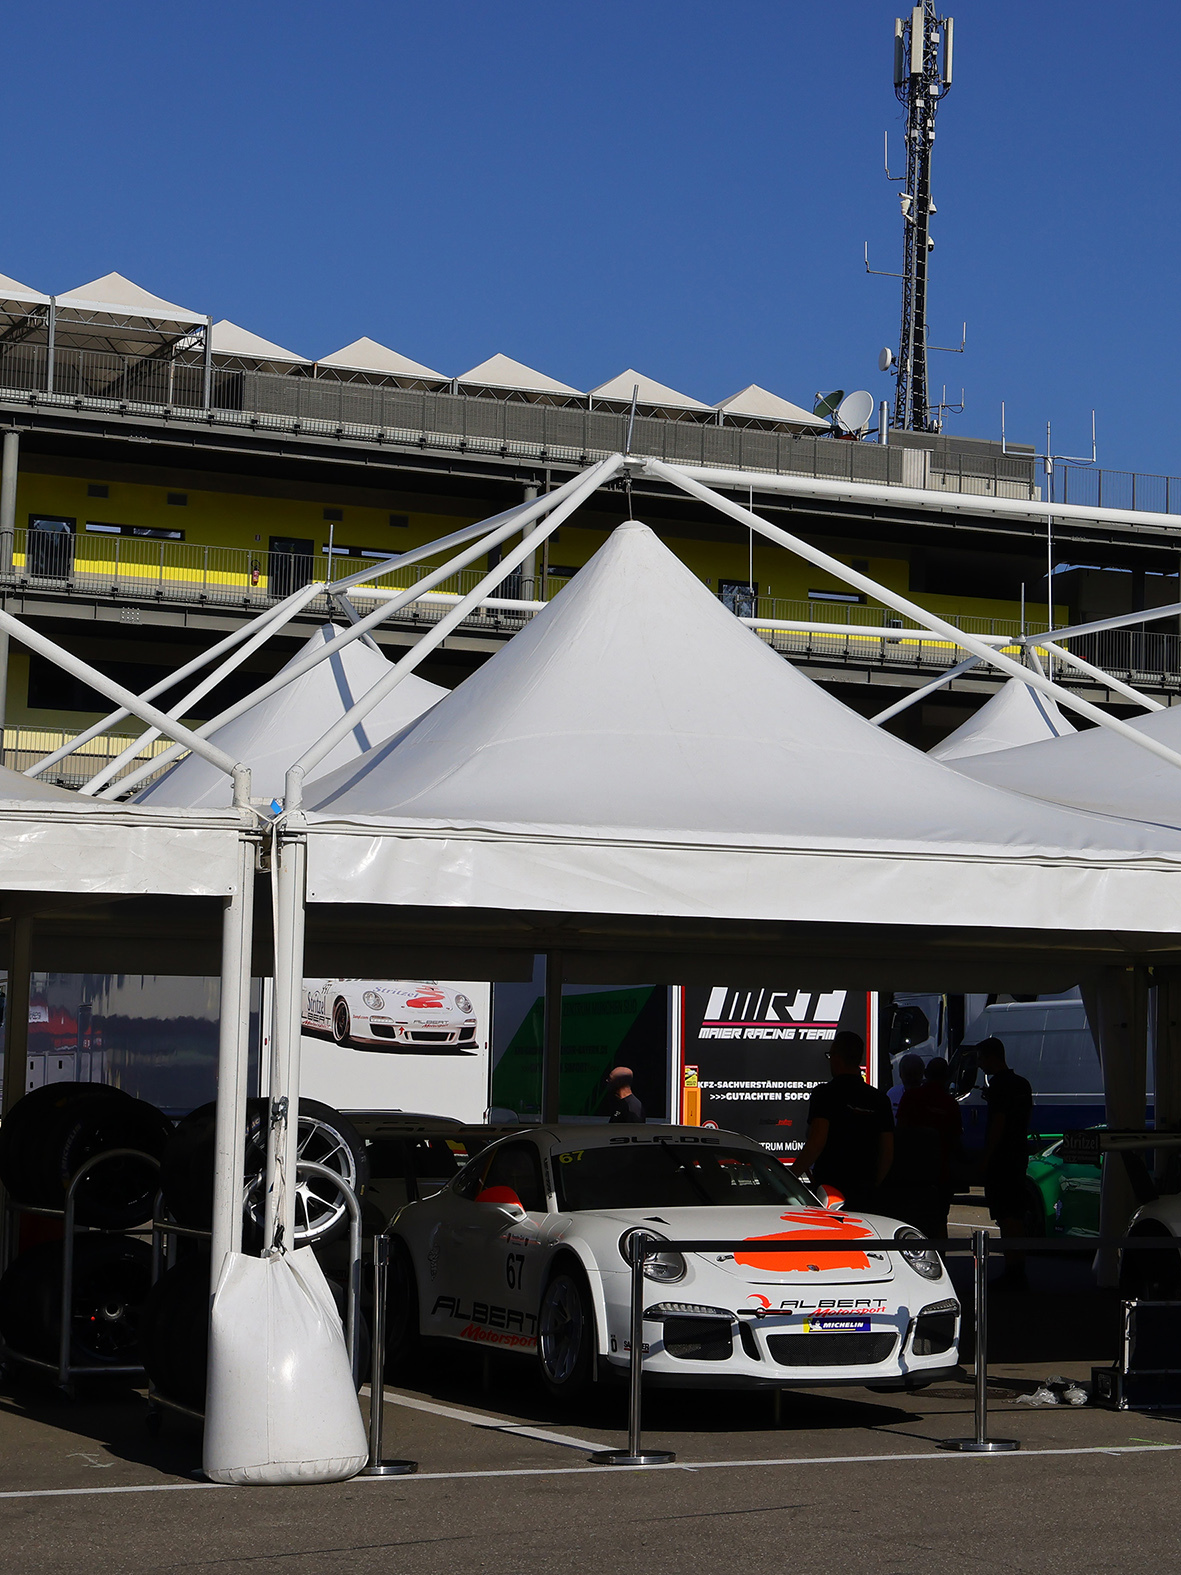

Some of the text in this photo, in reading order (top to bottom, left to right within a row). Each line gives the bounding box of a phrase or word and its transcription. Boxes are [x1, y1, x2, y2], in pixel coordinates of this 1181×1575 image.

[698, 1027, 837, 1040] MAIER RACING TEAM
[784, 1092, 812, 1101] SOFO
[784, 1140, 806, 1152] MÜN
[559, 1149, 585, 1165] 67
[506, 1252, 525, 1290] 67
[780, 1298, 888, 1309] ALBERT
[431, 1295, 537, 1335] ALBERT
[807, 1306, 887, 1318] Motorsport
[822, 1321, 864, 1329] MICHELIN
[460, 1323, 538, 1347] Motorsport
